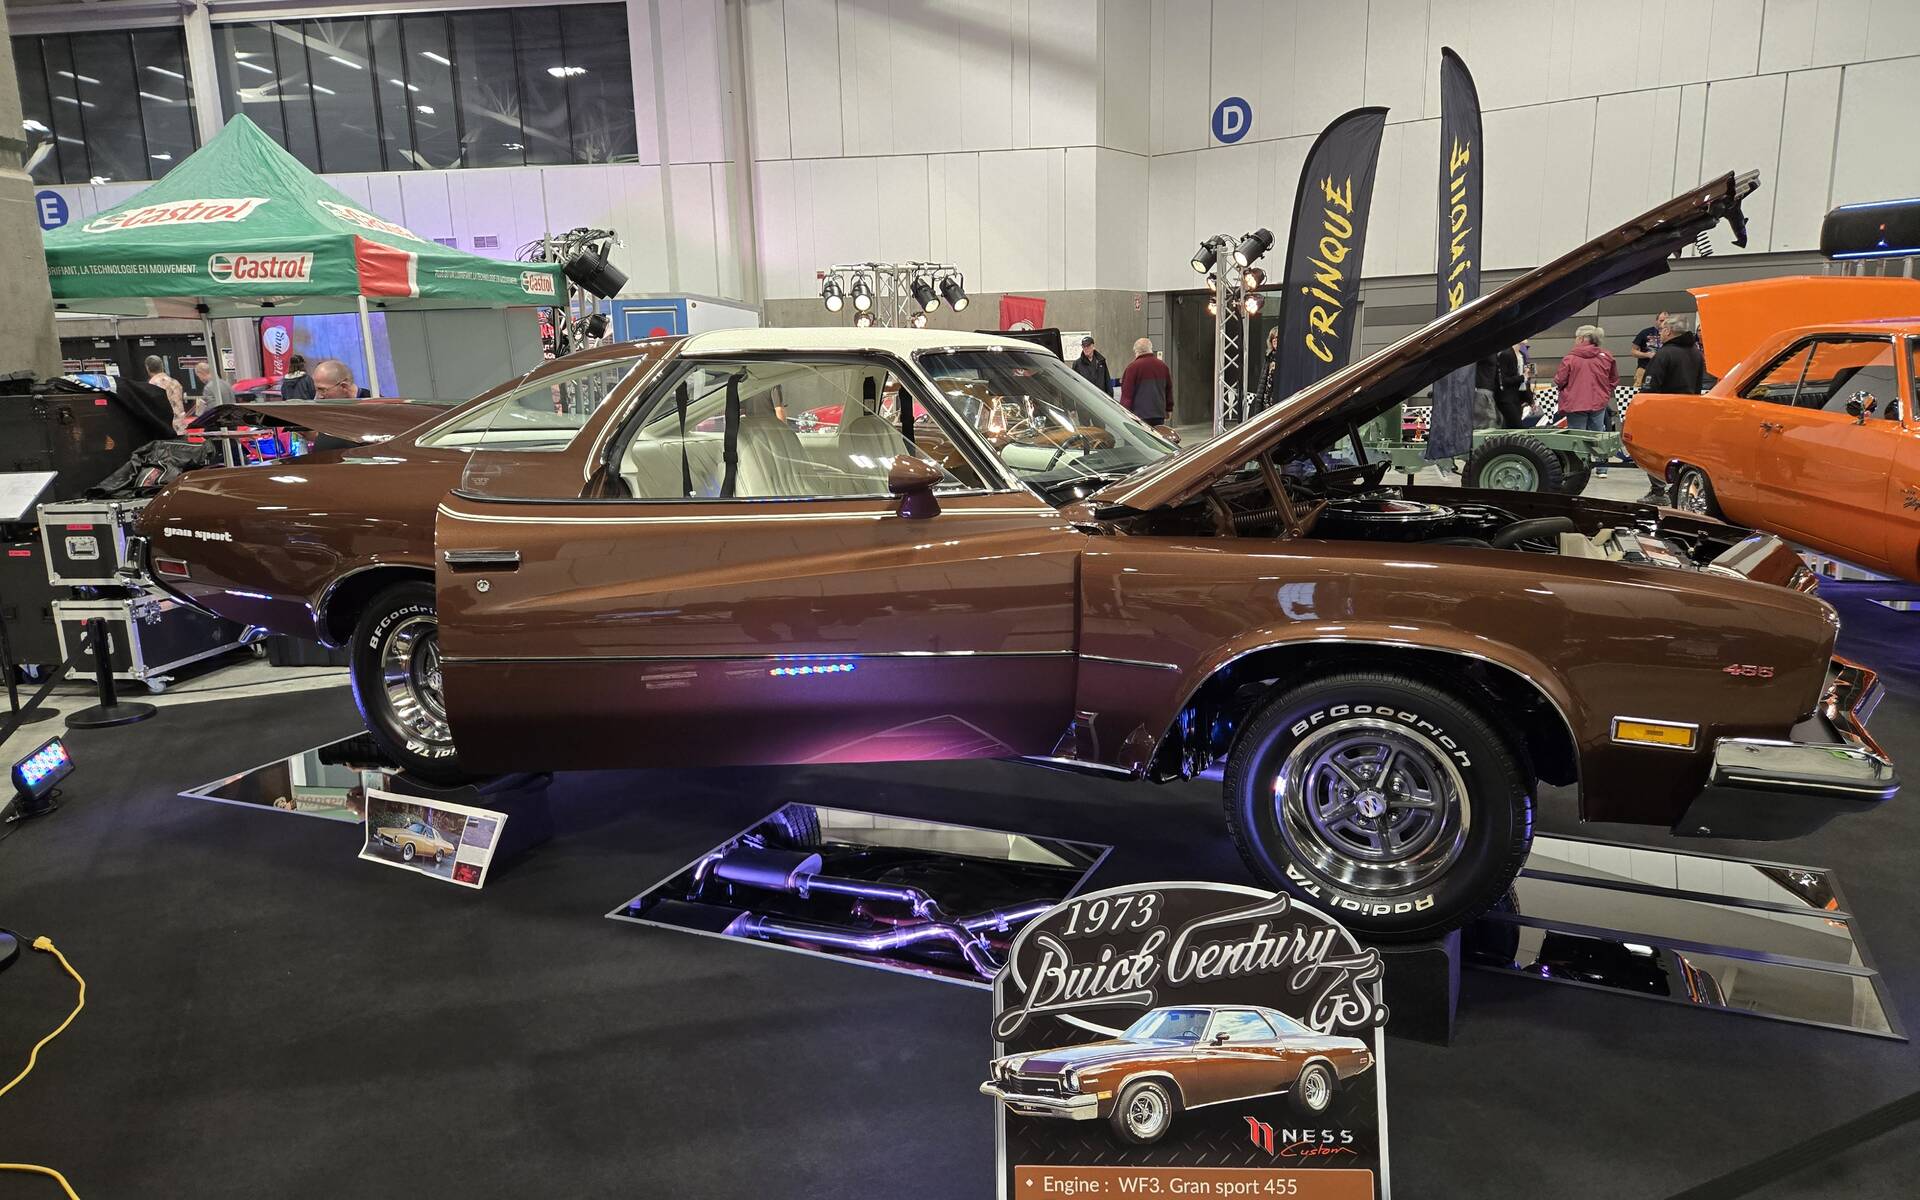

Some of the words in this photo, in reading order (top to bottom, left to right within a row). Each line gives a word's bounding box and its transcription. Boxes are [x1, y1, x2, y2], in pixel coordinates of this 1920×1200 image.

[1222, 105, 1244, 136] D
[41, 198, 60, 225] E
[121, 199, 252, 228] Castrol
[89, 264, 137, 275] TECHNOLOGIE
[138, 264, 150, 274] EN
[234, 256, 306, 279] Castrol
[529, 274, 554, 293] Castrol
[163, 526, 193, 538] gran
[194, 530, 233, 542] sport
[369, 604, 437, 650] BFGoodri
[1721, 663, 1775, 678] 455
[1290, 703, 1472, 768] BFGoodrich
[1285, 863, 1322, 899] T/A
[1062, 893, 1157, 936] 1973
[1330, 894, 1435, 917] Radial
[999, 930, 1166, 1037] Buick
[1168, 896, 1376, 990] Century
[1282, 1128, 1355, 1143] NESS
[1280, 1141, 1358, 1157] Custom
[1043, 1176, 1100, 1195] Engine
[1118, 1177, 1166, 1193] WF3.
[1169, 1177, 1211, 1193] Gran
[1215, 1179, 1260, 1196] sport
[1263, 1178, 1298, 1194] 455
